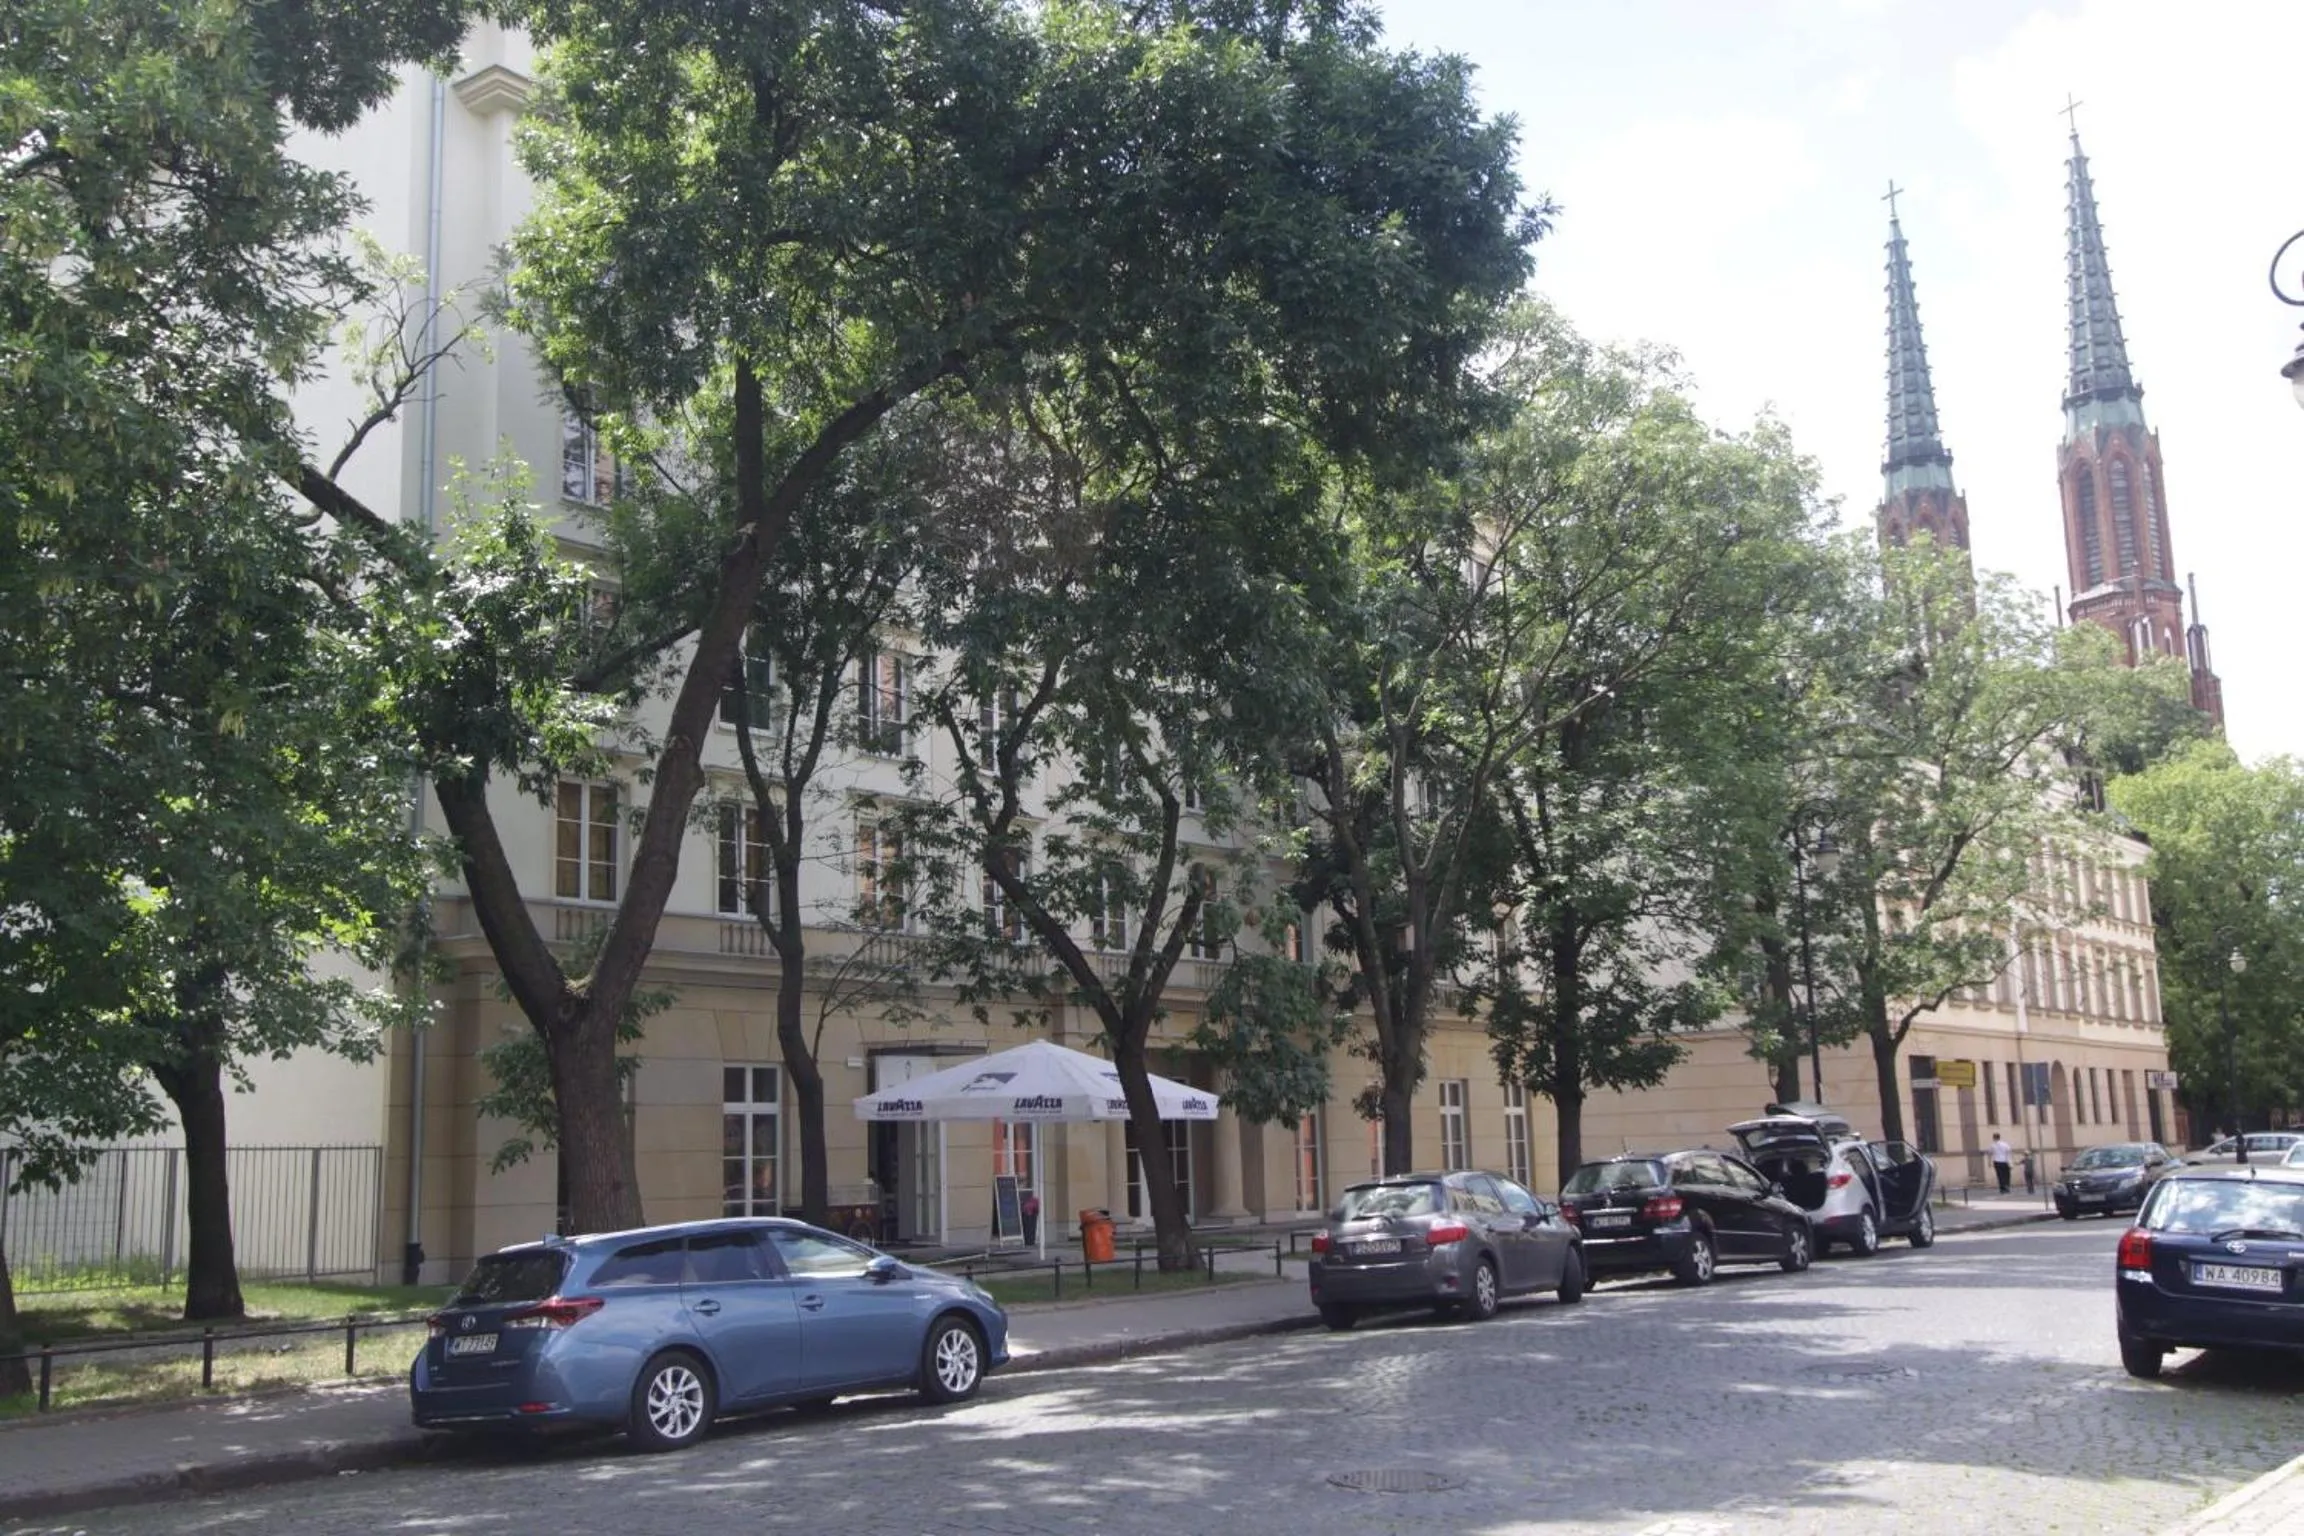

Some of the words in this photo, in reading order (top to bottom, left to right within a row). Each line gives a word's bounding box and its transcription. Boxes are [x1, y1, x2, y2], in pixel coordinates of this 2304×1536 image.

[877, 1098, 923, 1112] LAVAZZA
[1014, 1094, 1062, 1109] LAVAZZA
[2204, 1265, 2226, 1280] WA
